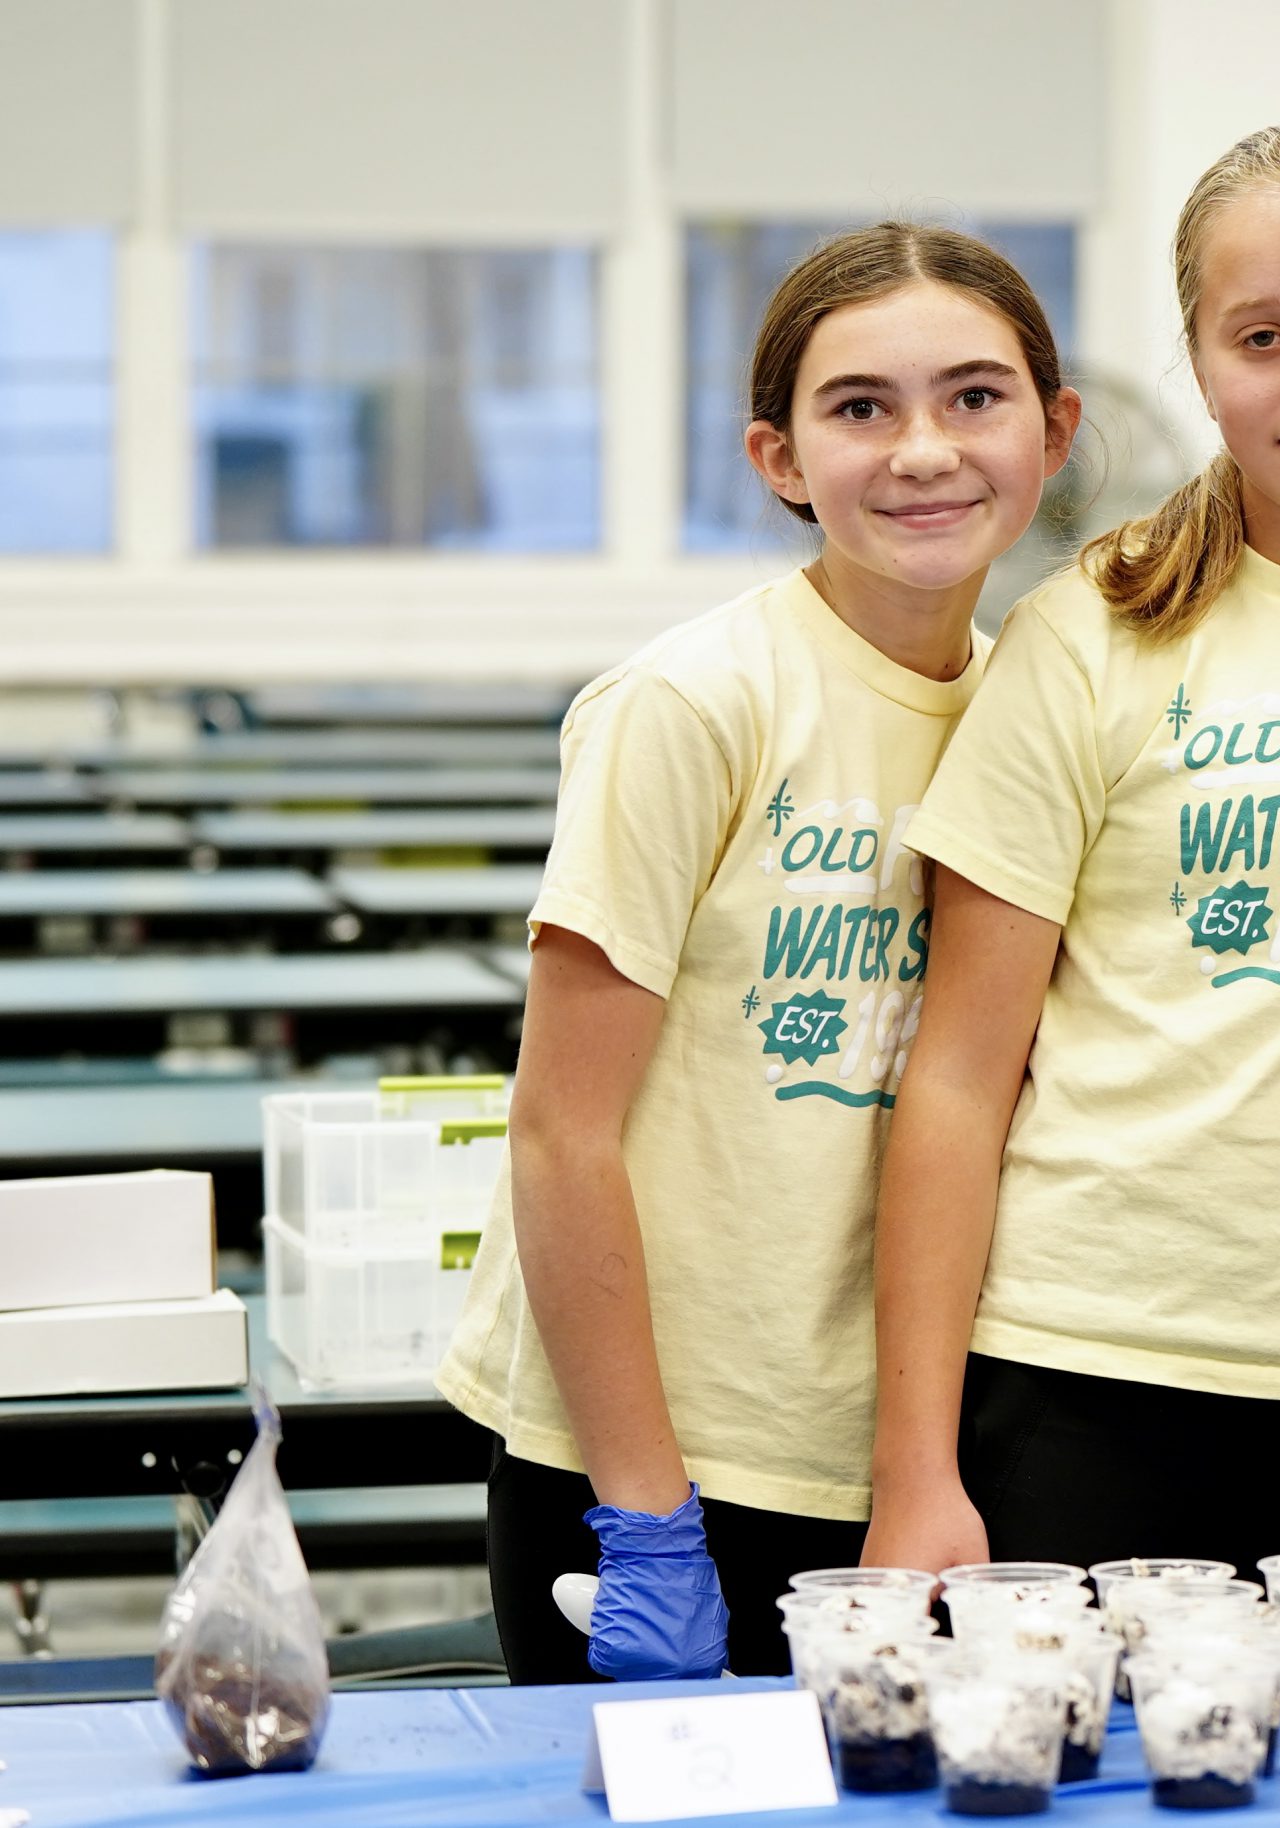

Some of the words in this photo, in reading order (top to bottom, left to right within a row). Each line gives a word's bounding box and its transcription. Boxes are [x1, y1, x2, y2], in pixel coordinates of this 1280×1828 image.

[781, 825, 878, 873] OLD
[1200, 898, 1264, 938] EST.
[763, 903, 900, 982] WATER
[775, 1006, 839, 1048] EST.
